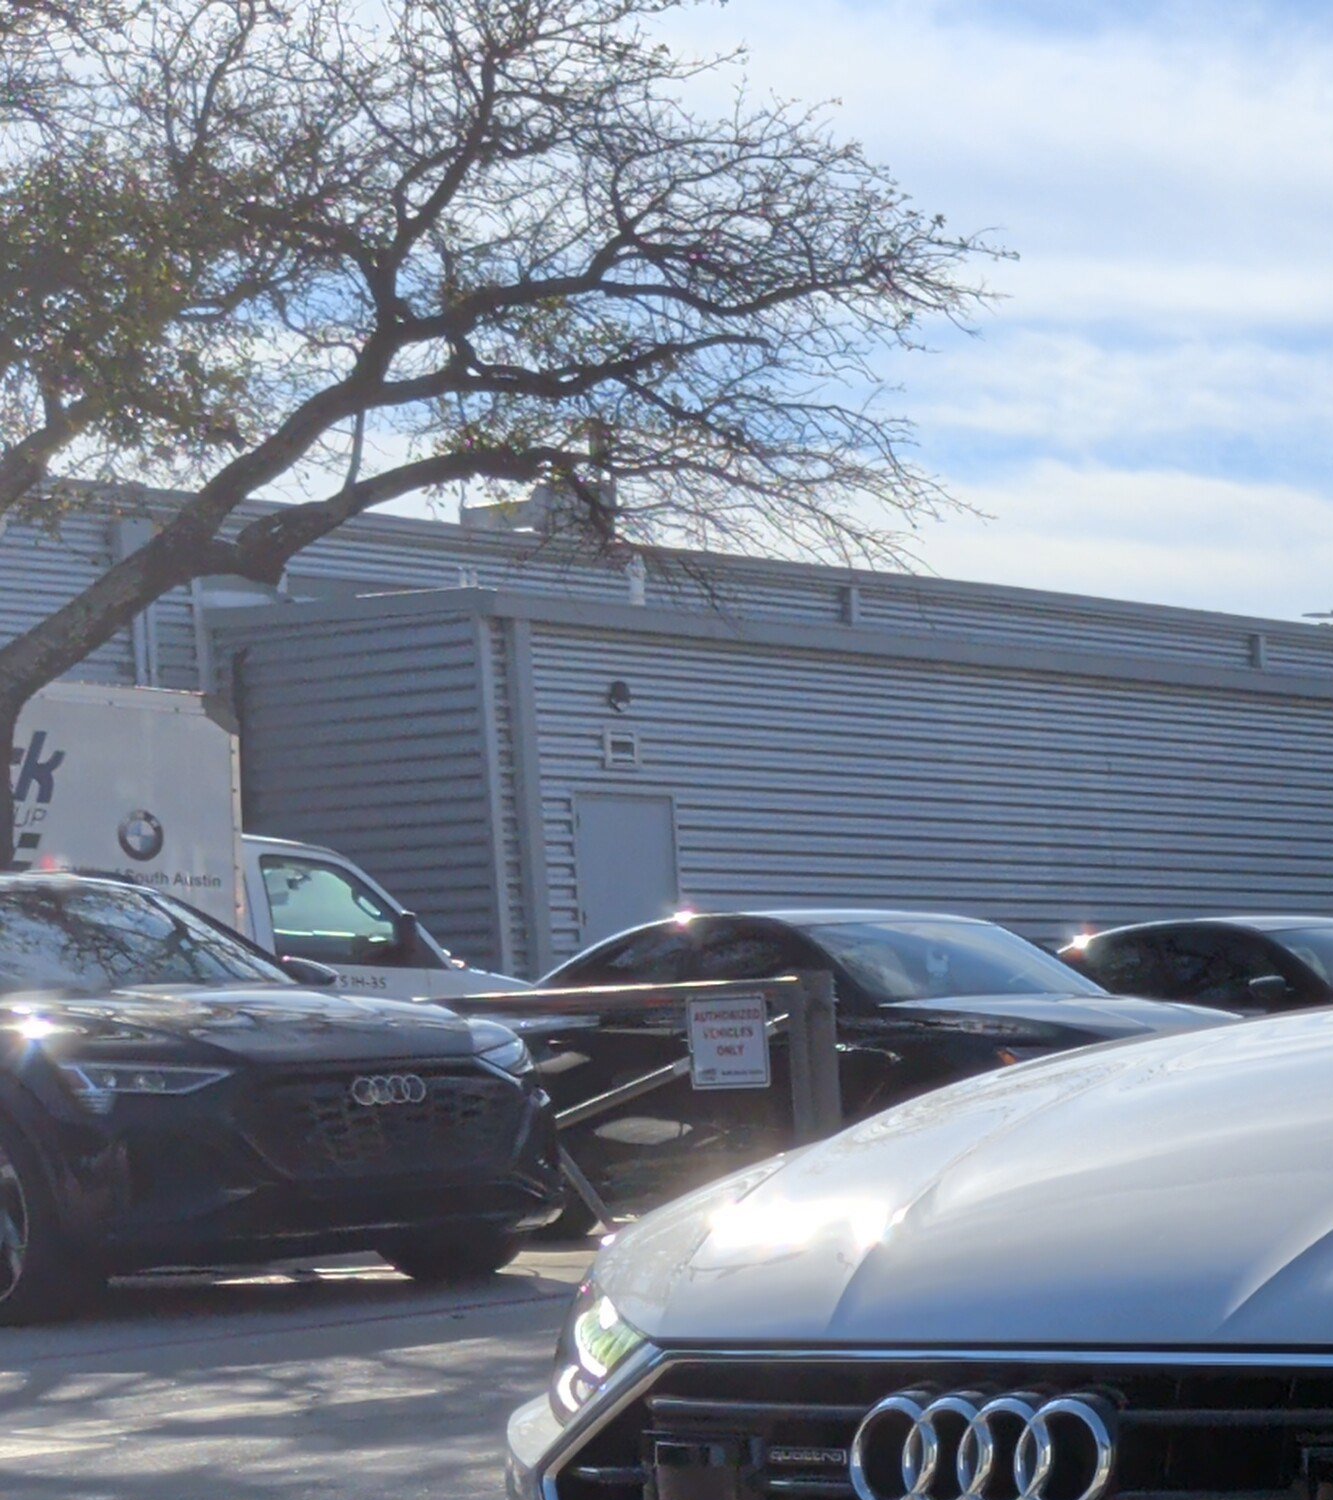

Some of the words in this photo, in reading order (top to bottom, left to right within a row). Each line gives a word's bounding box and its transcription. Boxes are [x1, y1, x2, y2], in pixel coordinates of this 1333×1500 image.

[172, 871, 221, 888] Austin
[694, 1008, 760, 1022] AUTHORIZED
[703, 1026, 753, 1039] VEHICLES
[716, 1045, 744, 1056] ONLY
[769, 1450, 842, 1462] quattro
